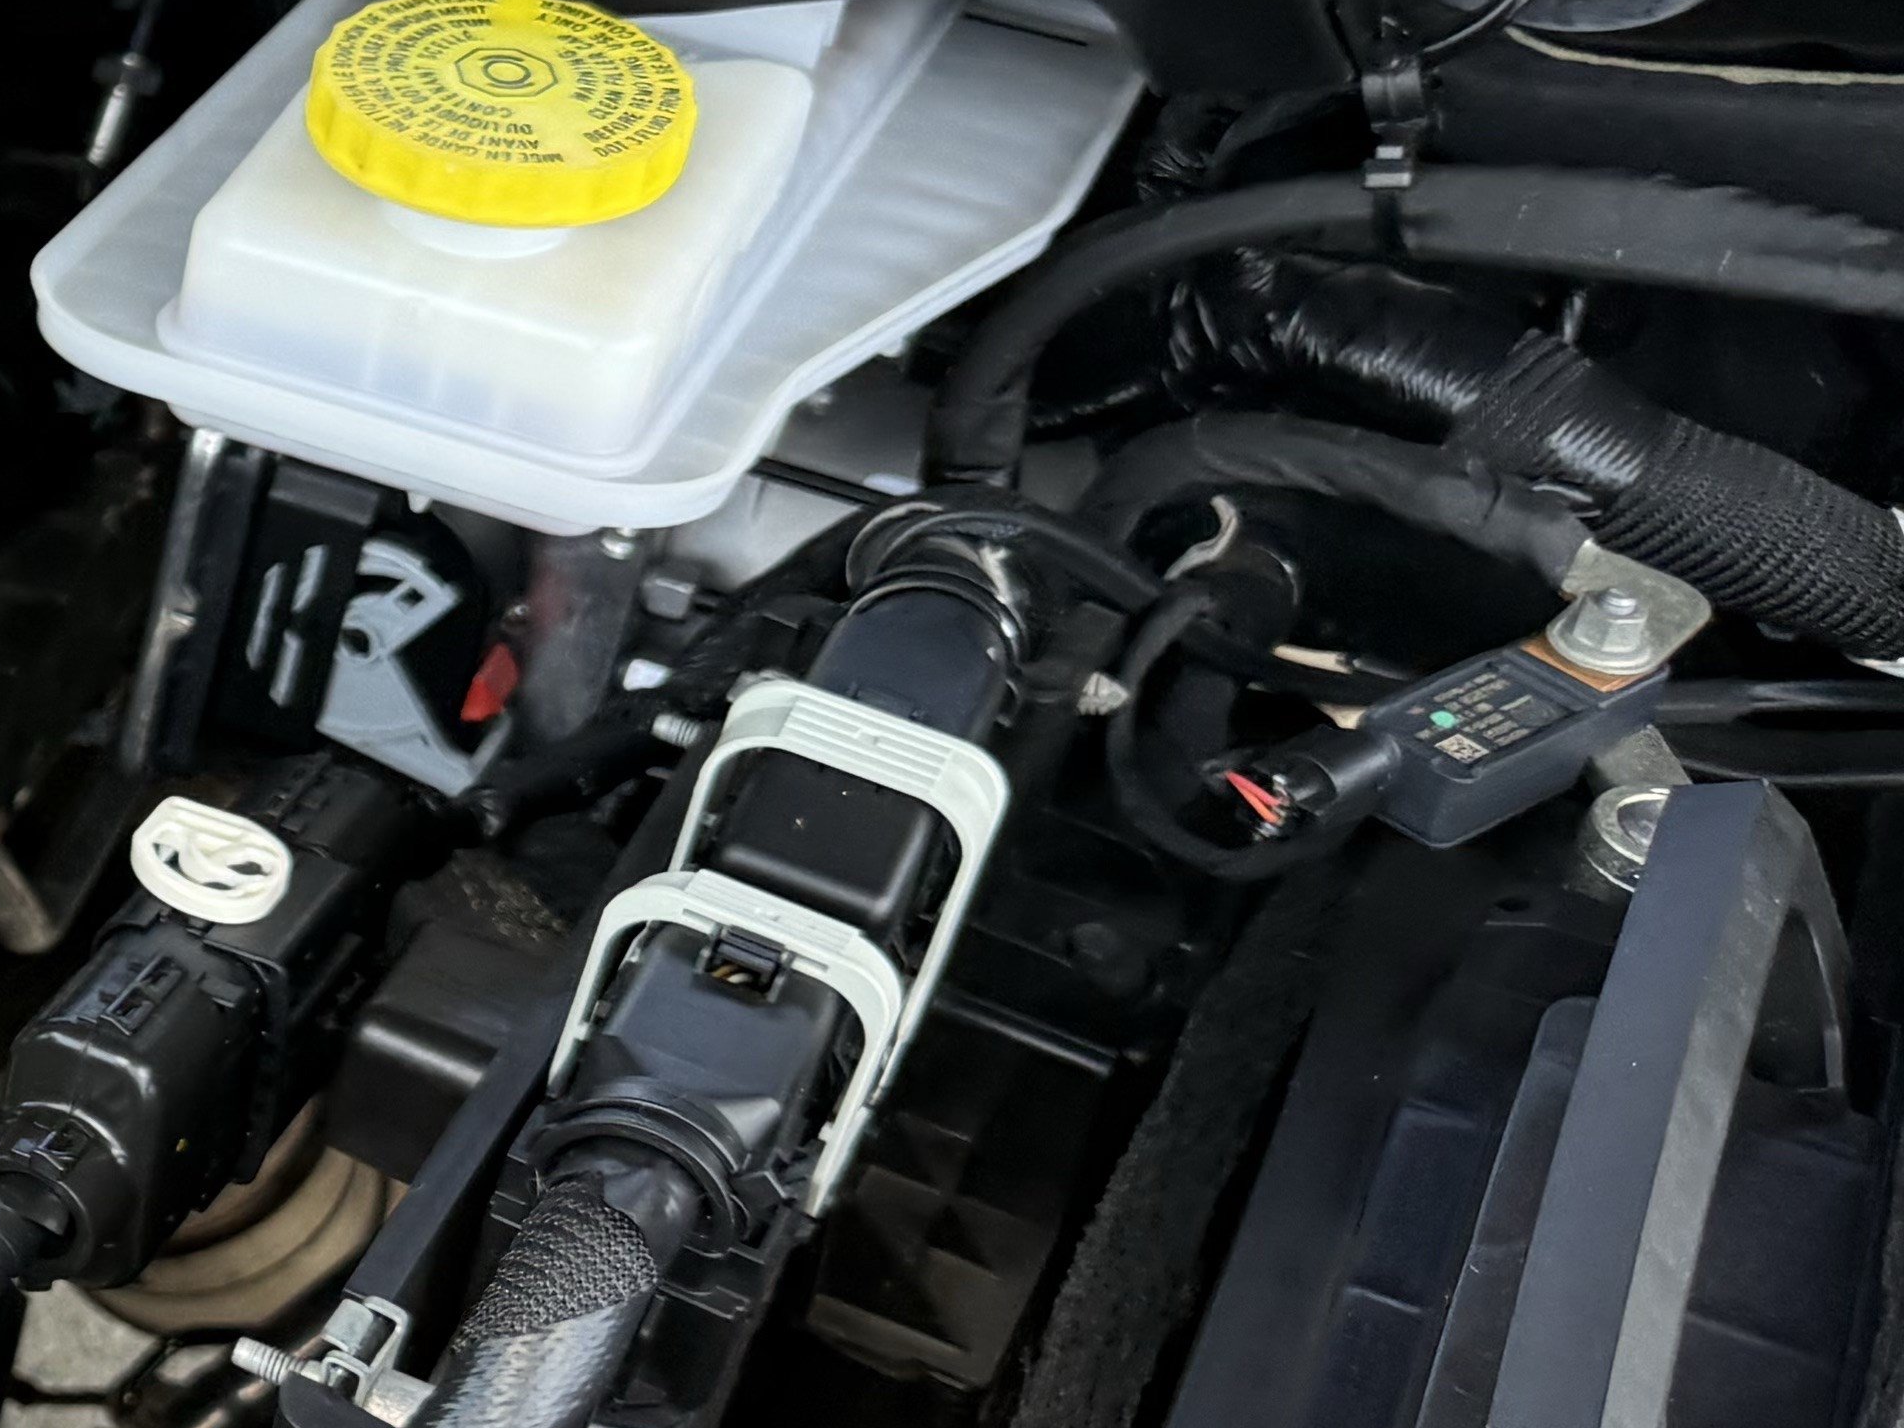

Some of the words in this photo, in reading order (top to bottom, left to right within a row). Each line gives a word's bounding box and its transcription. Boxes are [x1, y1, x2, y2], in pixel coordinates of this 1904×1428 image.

[587, 89, 626, 121] CLEAN
[505, 122, 534, 135] DU
[582, 111, 645, 143] BEFORE
[478, 135, 541, 150] AVANT
[592, 140, 630, 158] DOT
